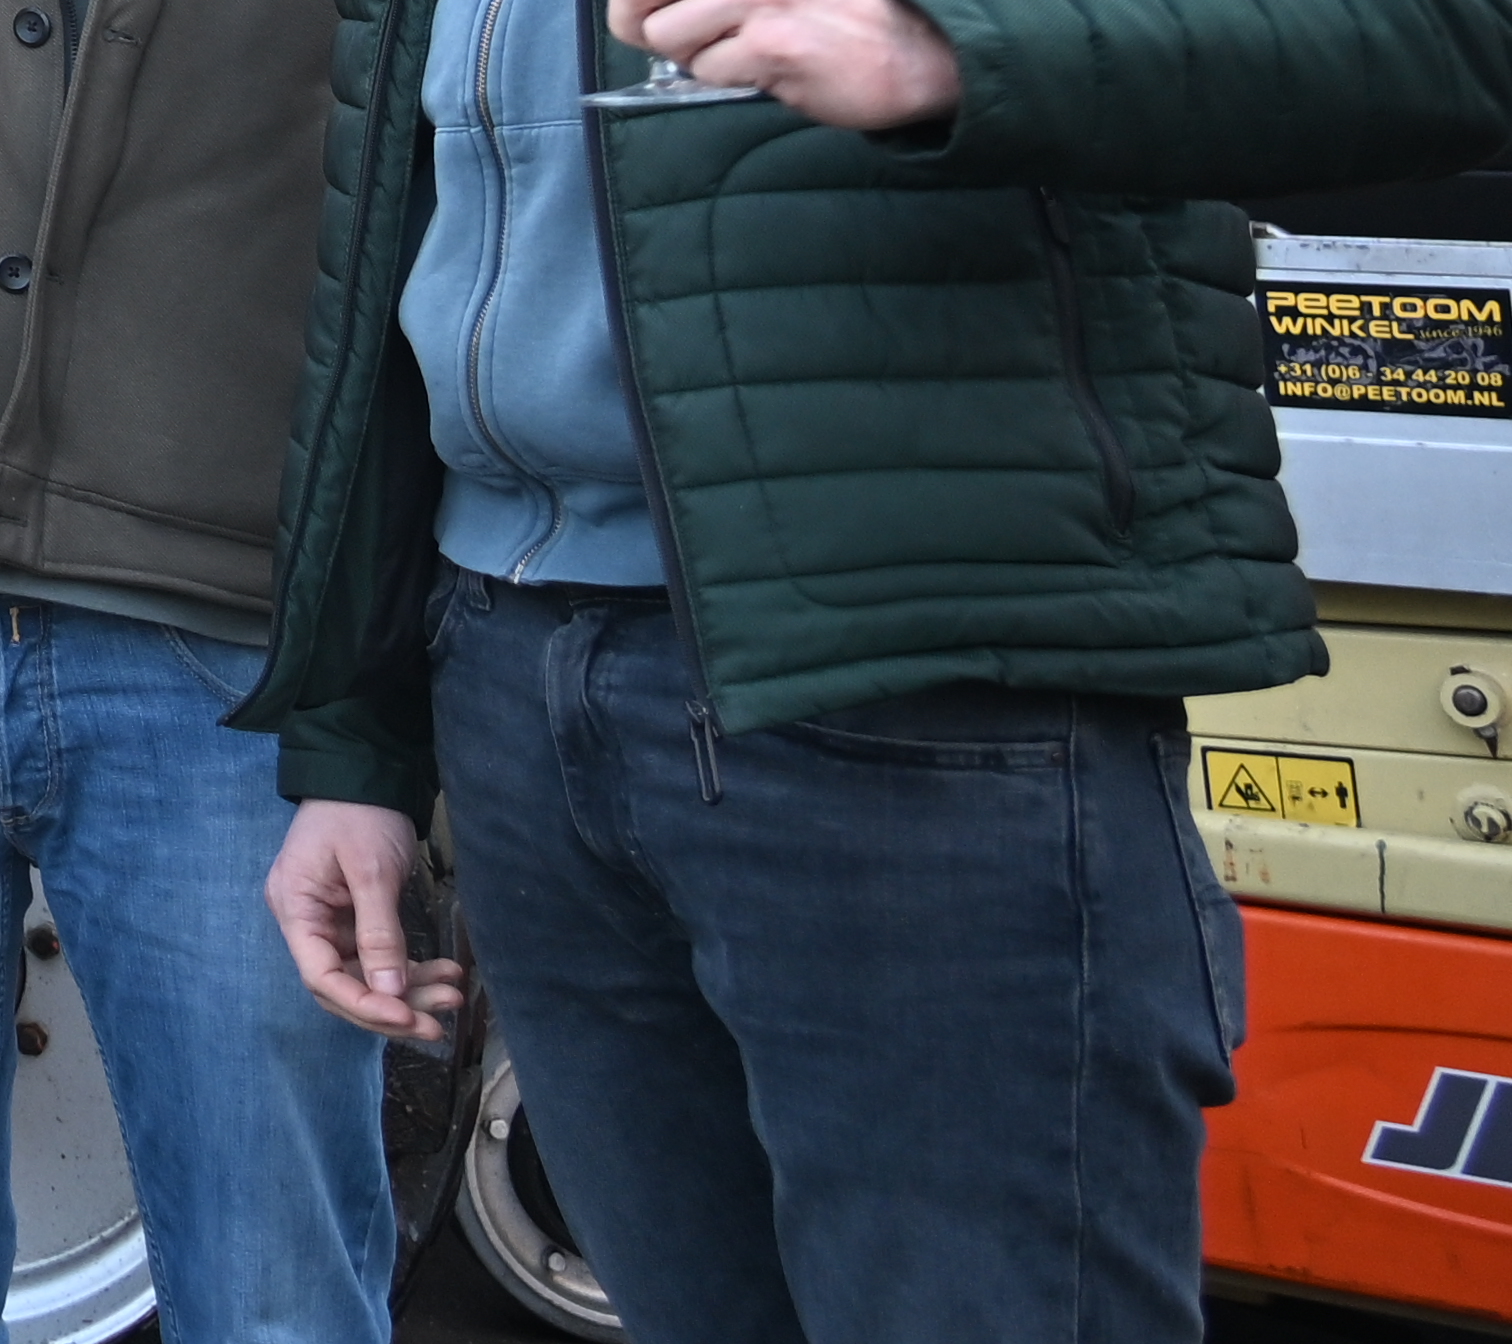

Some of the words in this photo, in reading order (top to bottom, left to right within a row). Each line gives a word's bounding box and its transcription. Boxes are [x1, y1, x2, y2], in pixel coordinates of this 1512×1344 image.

[1269, 316, 1415, 339] WINKEL
[1418, 326, 1460, 339] since
[1467, 325, 1503, 337] 1946
[1277, 363, 1313, 377] +31
[1320, 364, 1361, 381] (0)6
[1380, 366, 1406, 381] 34
[1412, 368, 1438, 383] 44
[1444, 370, 1470, 385] 20
[1477, 372, 1503, 387] 08
[1278, 381, 1506, 407] INFO@PEETOOM.NL
